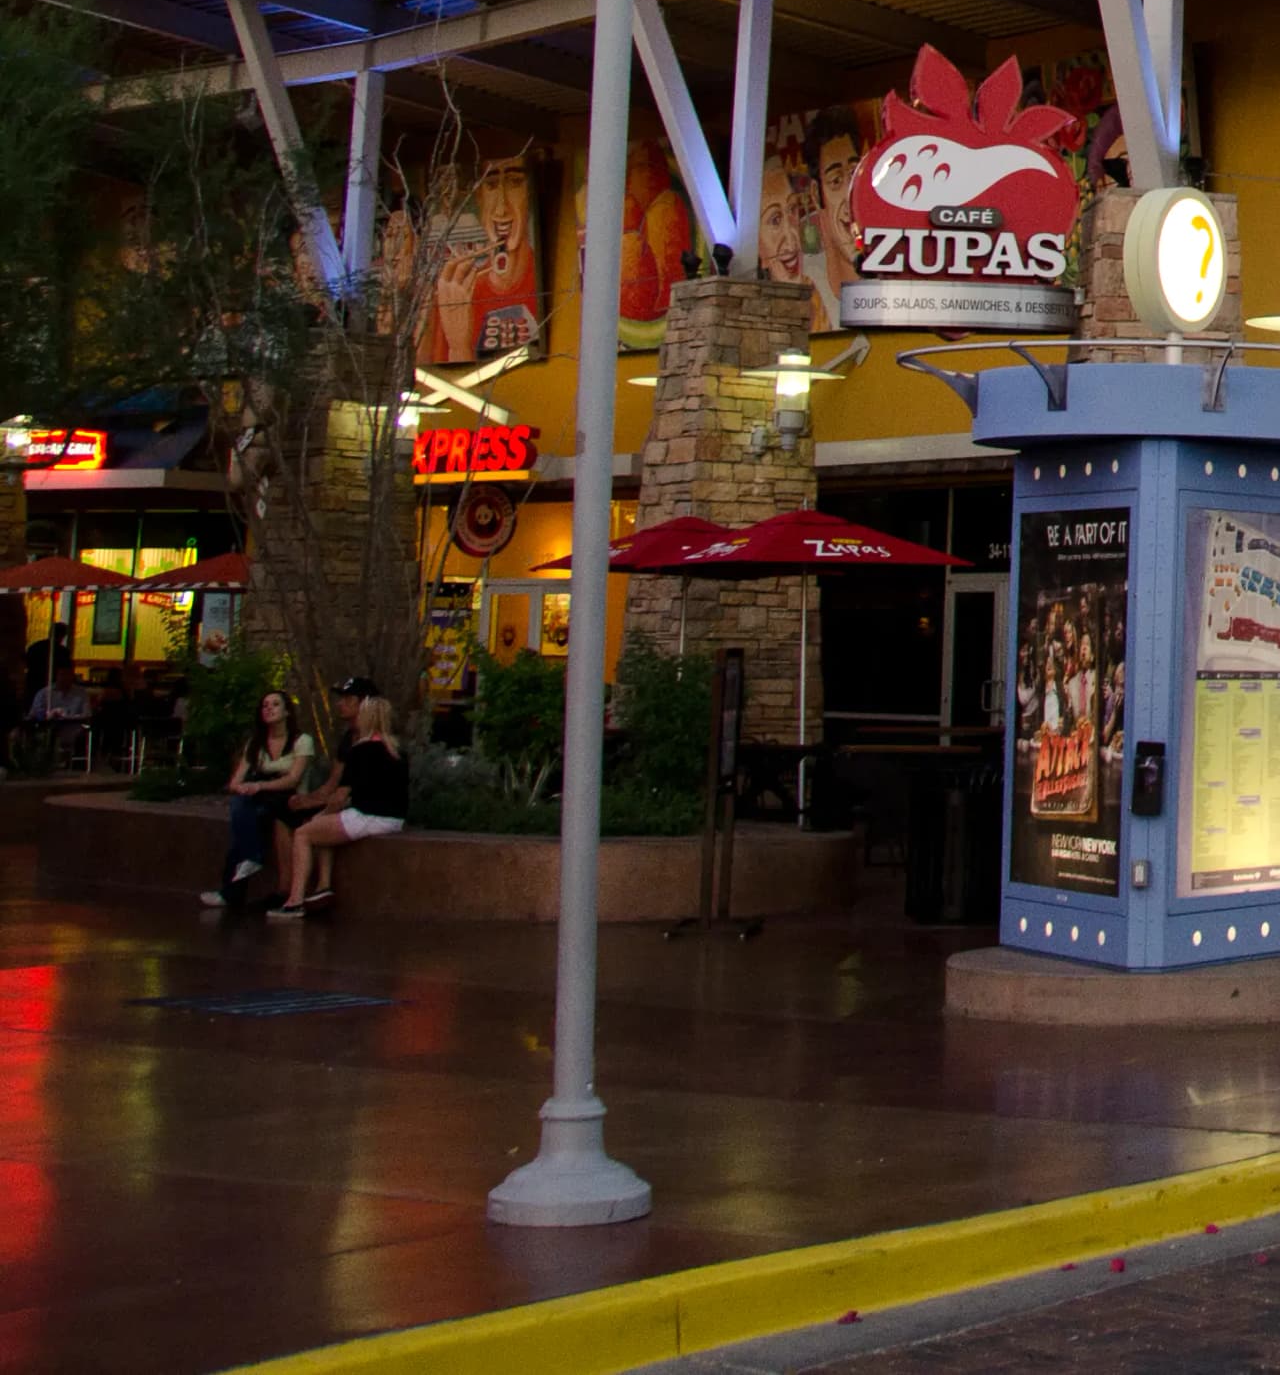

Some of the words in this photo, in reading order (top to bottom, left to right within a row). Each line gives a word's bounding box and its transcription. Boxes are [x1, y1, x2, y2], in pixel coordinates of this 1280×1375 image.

[938, 208, 993, 224] CAFÉ
[861, 227, 1067, 278] ZUPAS
[852, 296, 891, 311] SOUPS,
[893, 297, 938, 312] SALADS,
[940, 298, 1014, 315] SANDWICHES,
[1014, 301, 1022, 313] &
[411, 424, 531, 474] XPRESS
[803, 539, 891, 558] Zupas
